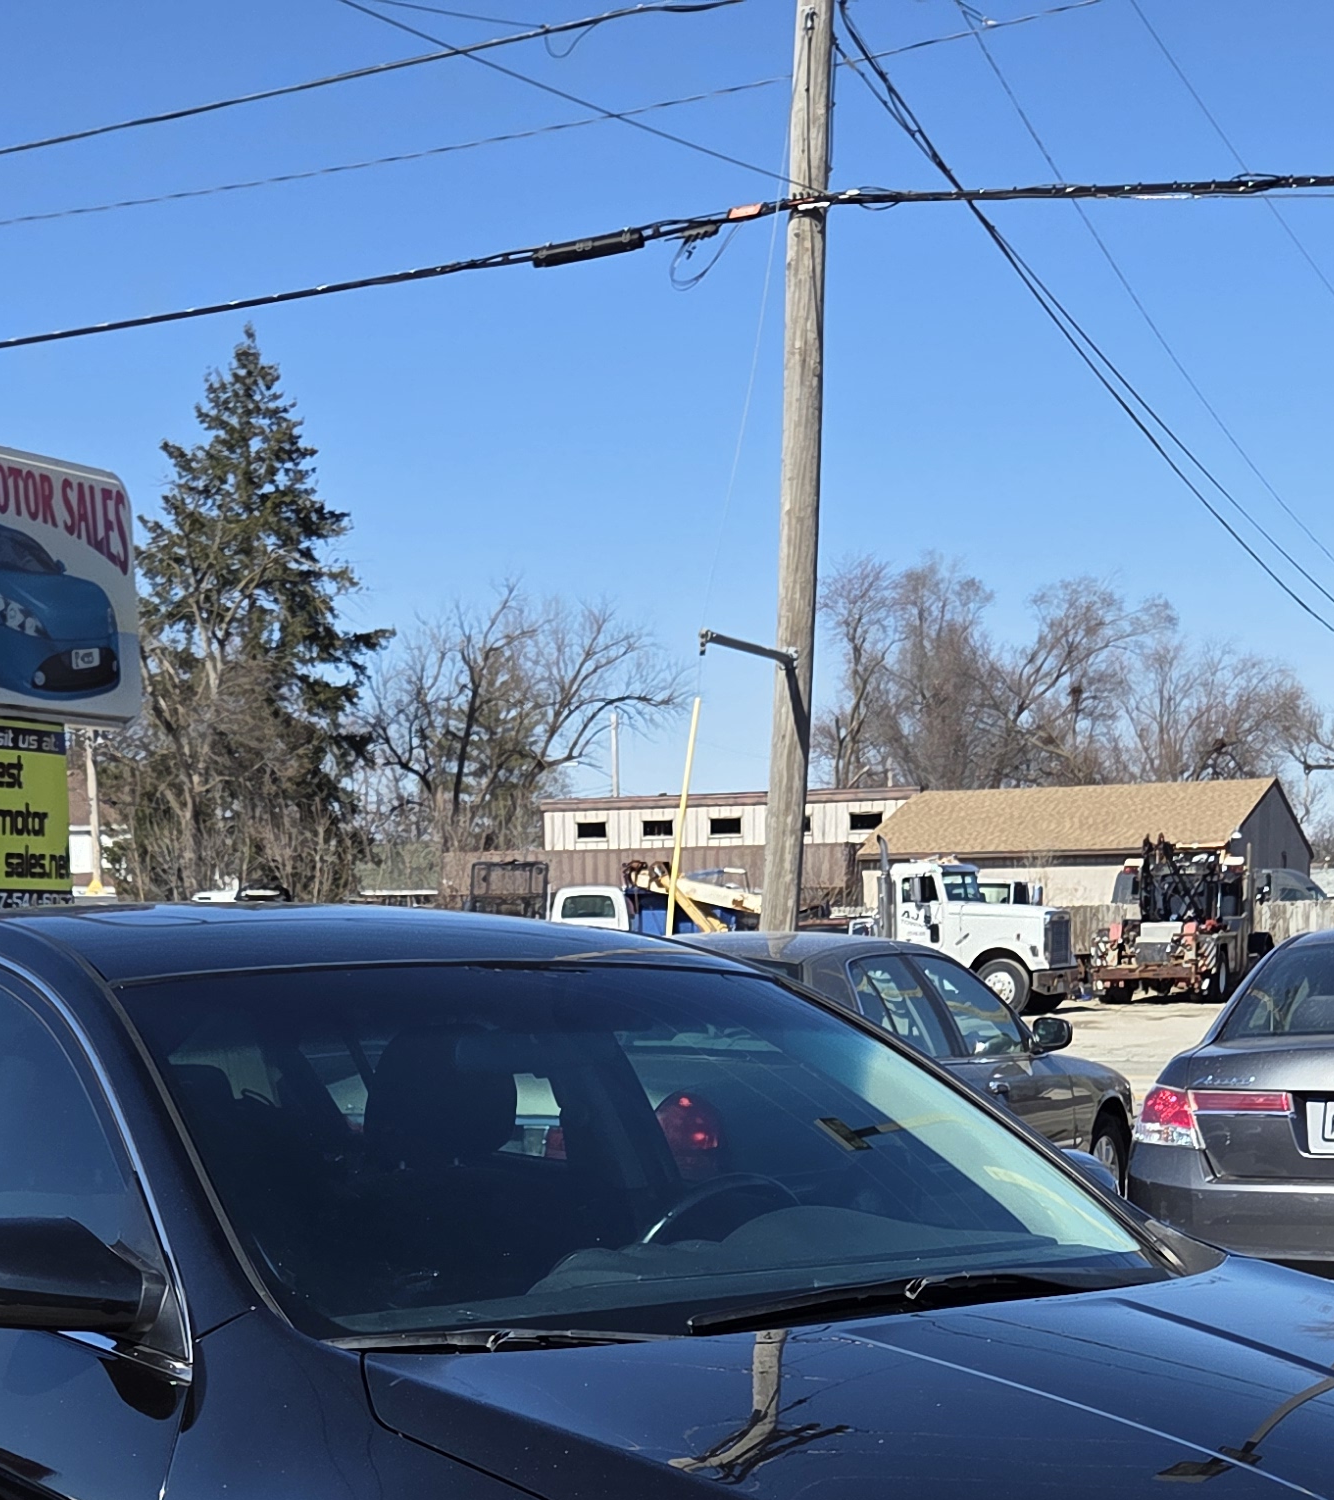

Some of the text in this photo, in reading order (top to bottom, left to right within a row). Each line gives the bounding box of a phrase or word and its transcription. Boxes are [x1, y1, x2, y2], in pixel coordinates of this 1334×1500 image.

[61, 477, 129, 576] SALES
[18, 734, 38, 749] us
[5, 845, 70, 880] sales.net
